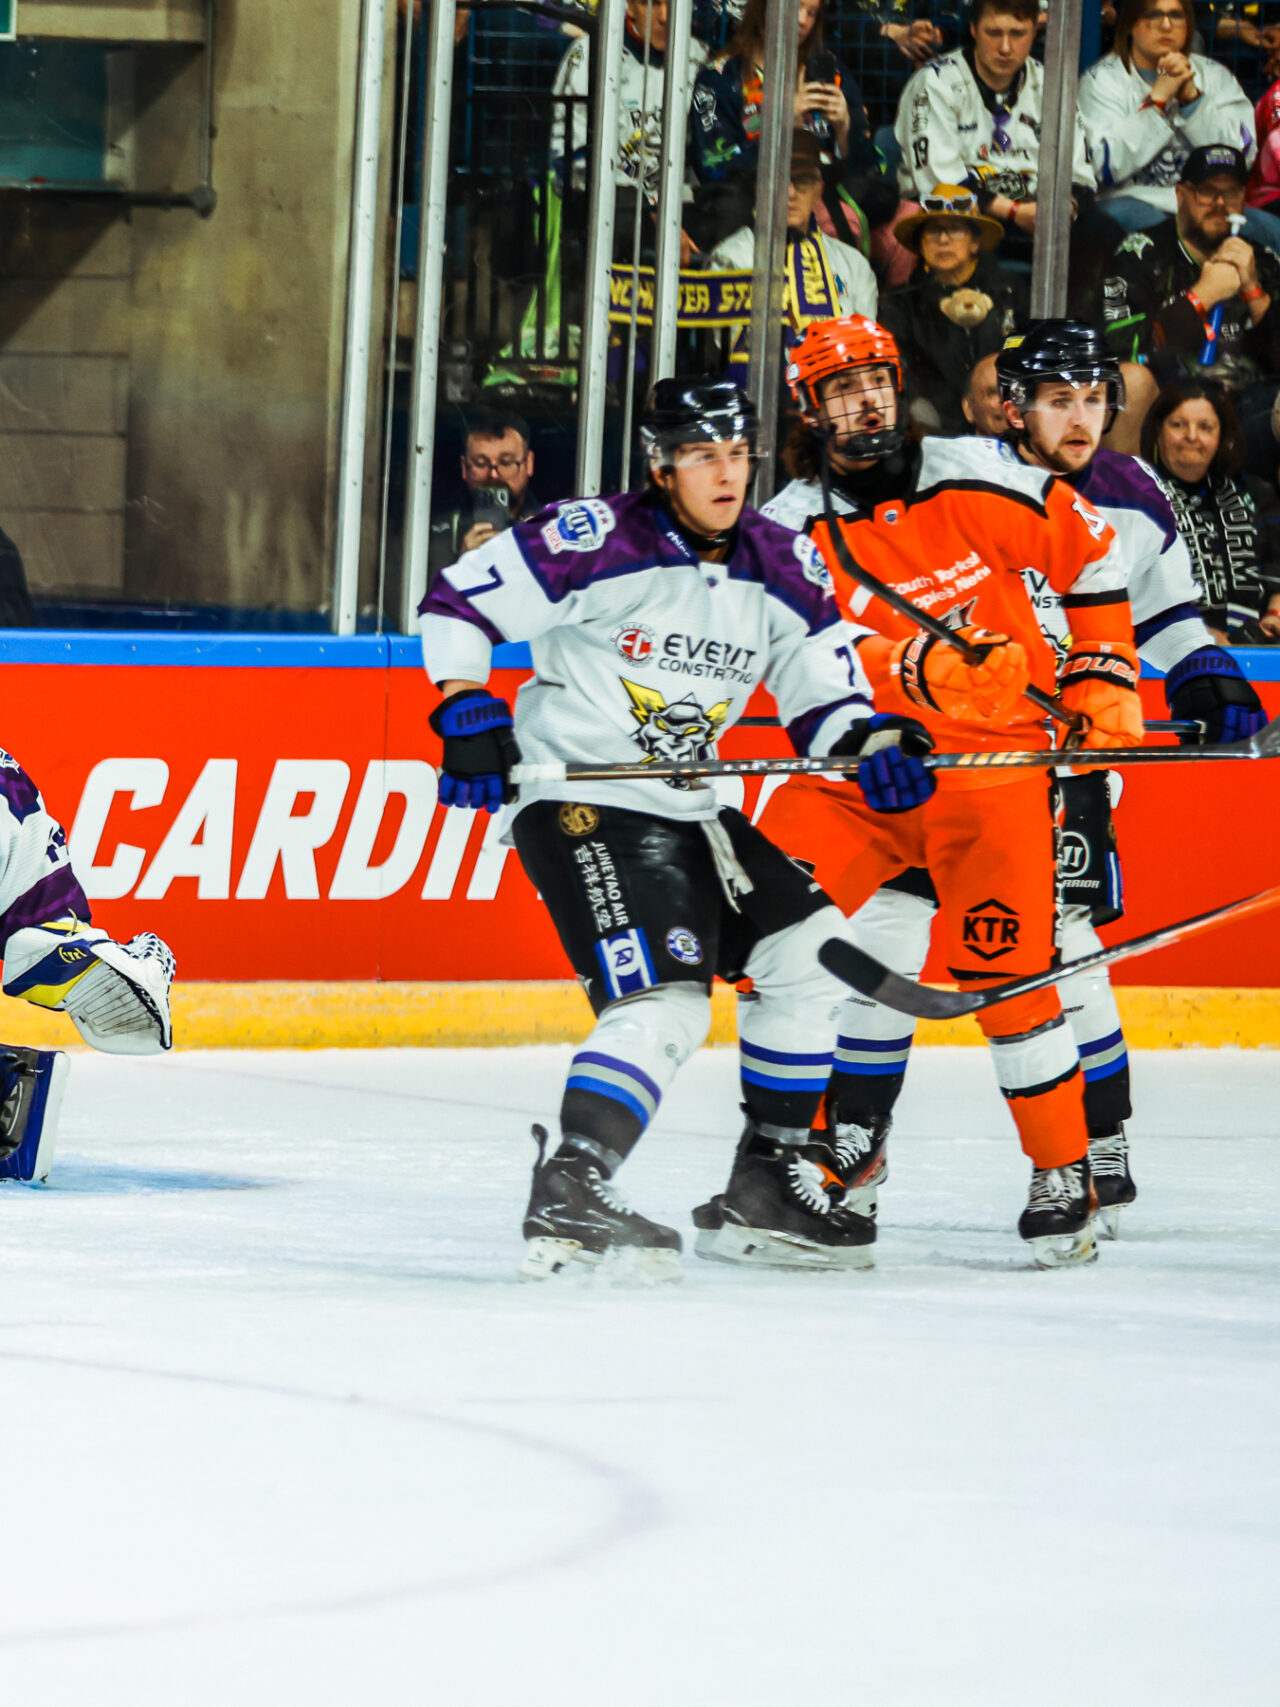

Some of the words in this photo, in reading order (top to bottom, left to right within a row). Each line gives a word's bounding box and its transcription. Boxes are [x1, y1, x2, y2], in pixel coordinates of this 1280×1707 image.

[459, 564, 504, 598] 7
[69, 757, 543, 899] CARDI
[591, 841, 621, 901] JUNEYAO
[613, 902, 630, 926] AIR
[1062, 879, 1100, 889] ARRIOR
[963, 915, 1020, 944] KTR
